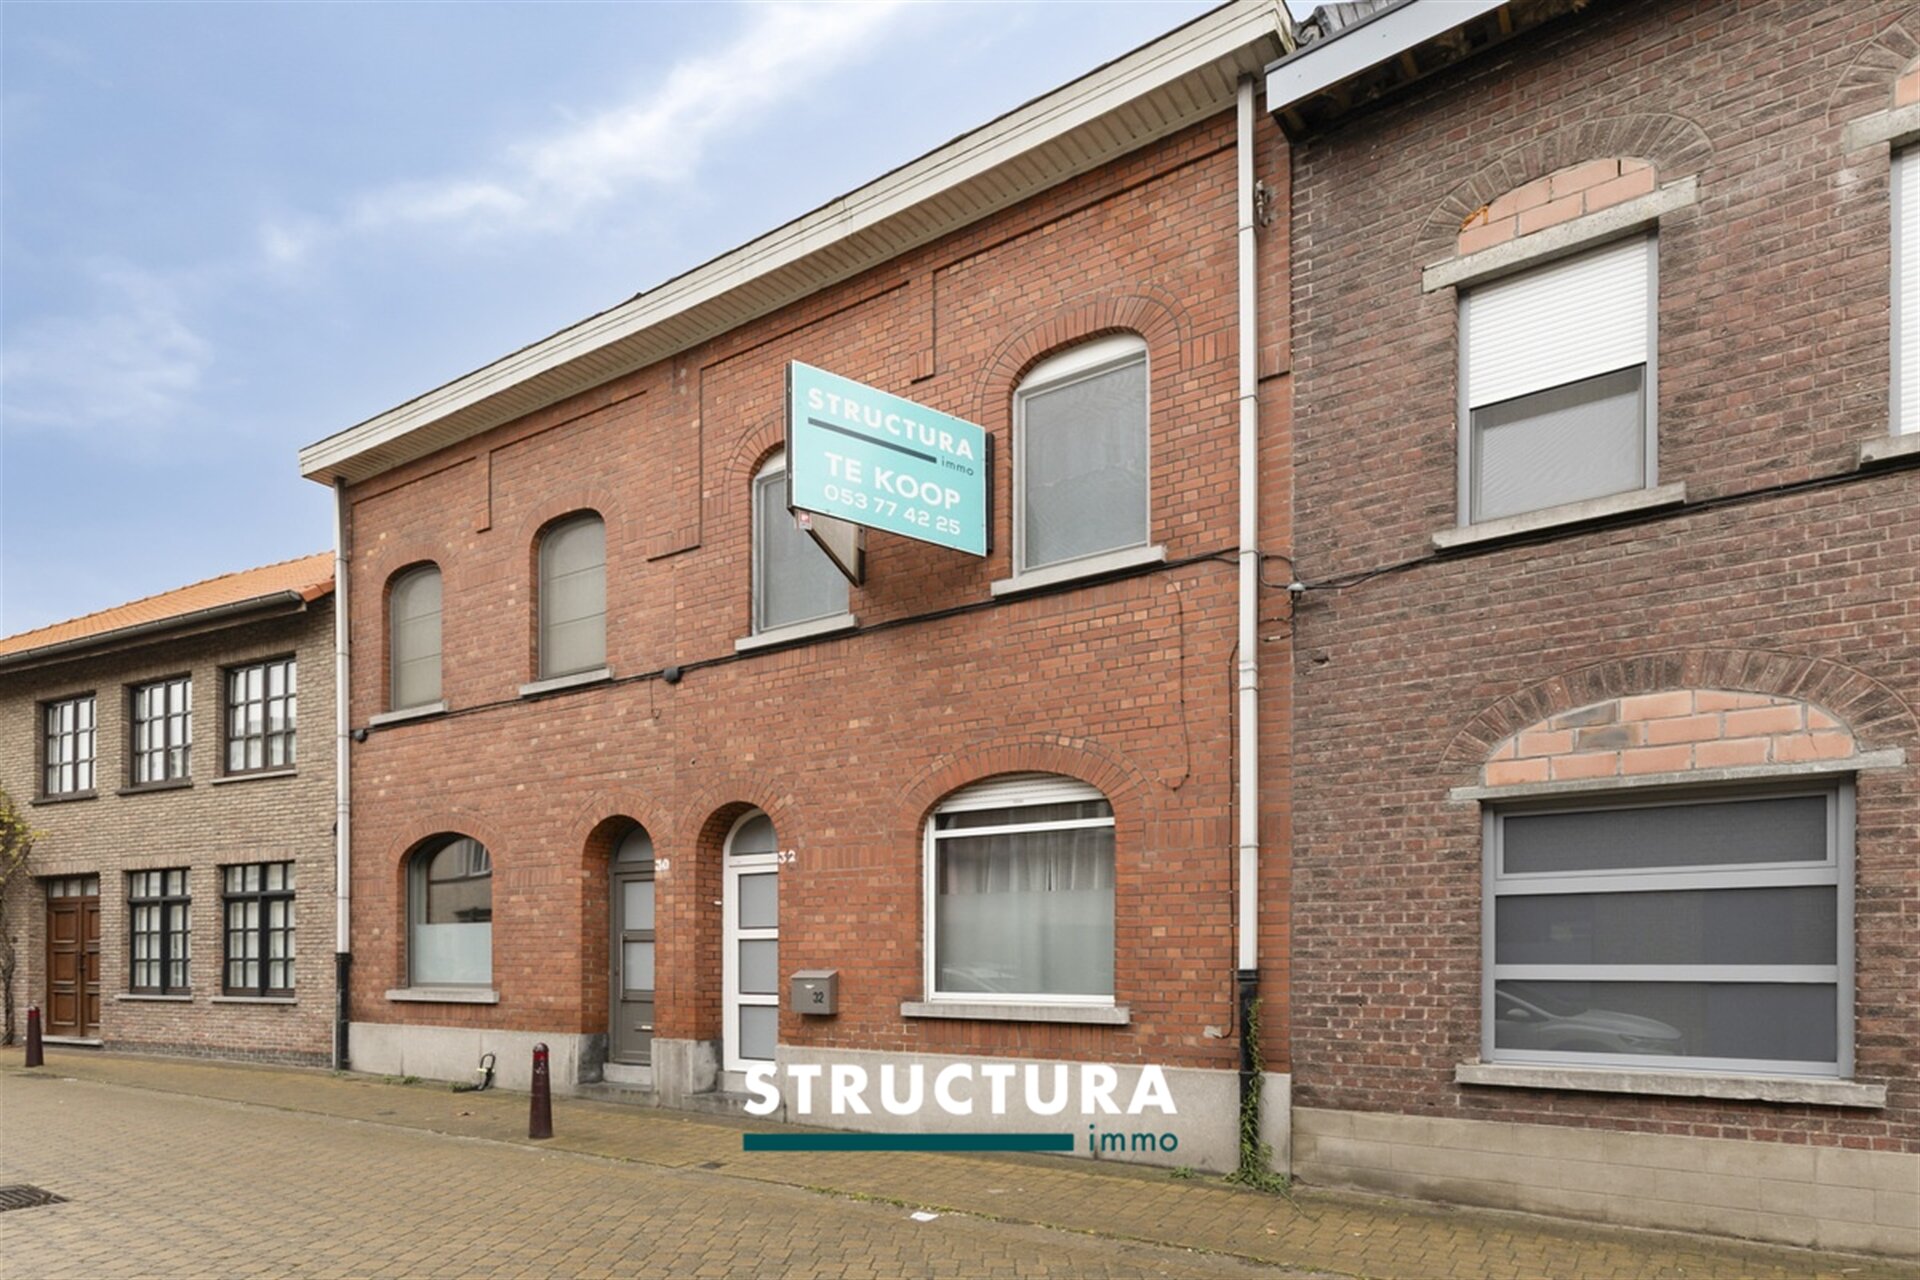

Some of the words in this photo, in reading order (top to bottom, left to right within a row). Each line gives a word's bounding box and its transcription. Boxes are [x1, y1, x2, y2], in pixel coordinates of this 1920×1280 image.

[808, 387, 974, 460] STRUCTURA
[824, 451, 862, 484] TE
[874, 466, 961, 510] KOOP
[942, 456, 974, 476] immo
[824, 484, 868, 510] 053
[873, 498, 897, 517] 77
[903, 507, 930, 527] 42
[936, 516, 961, 535] 25
[778, 849, 796, 864] 32
[812, 991, 824, 1004] 32
